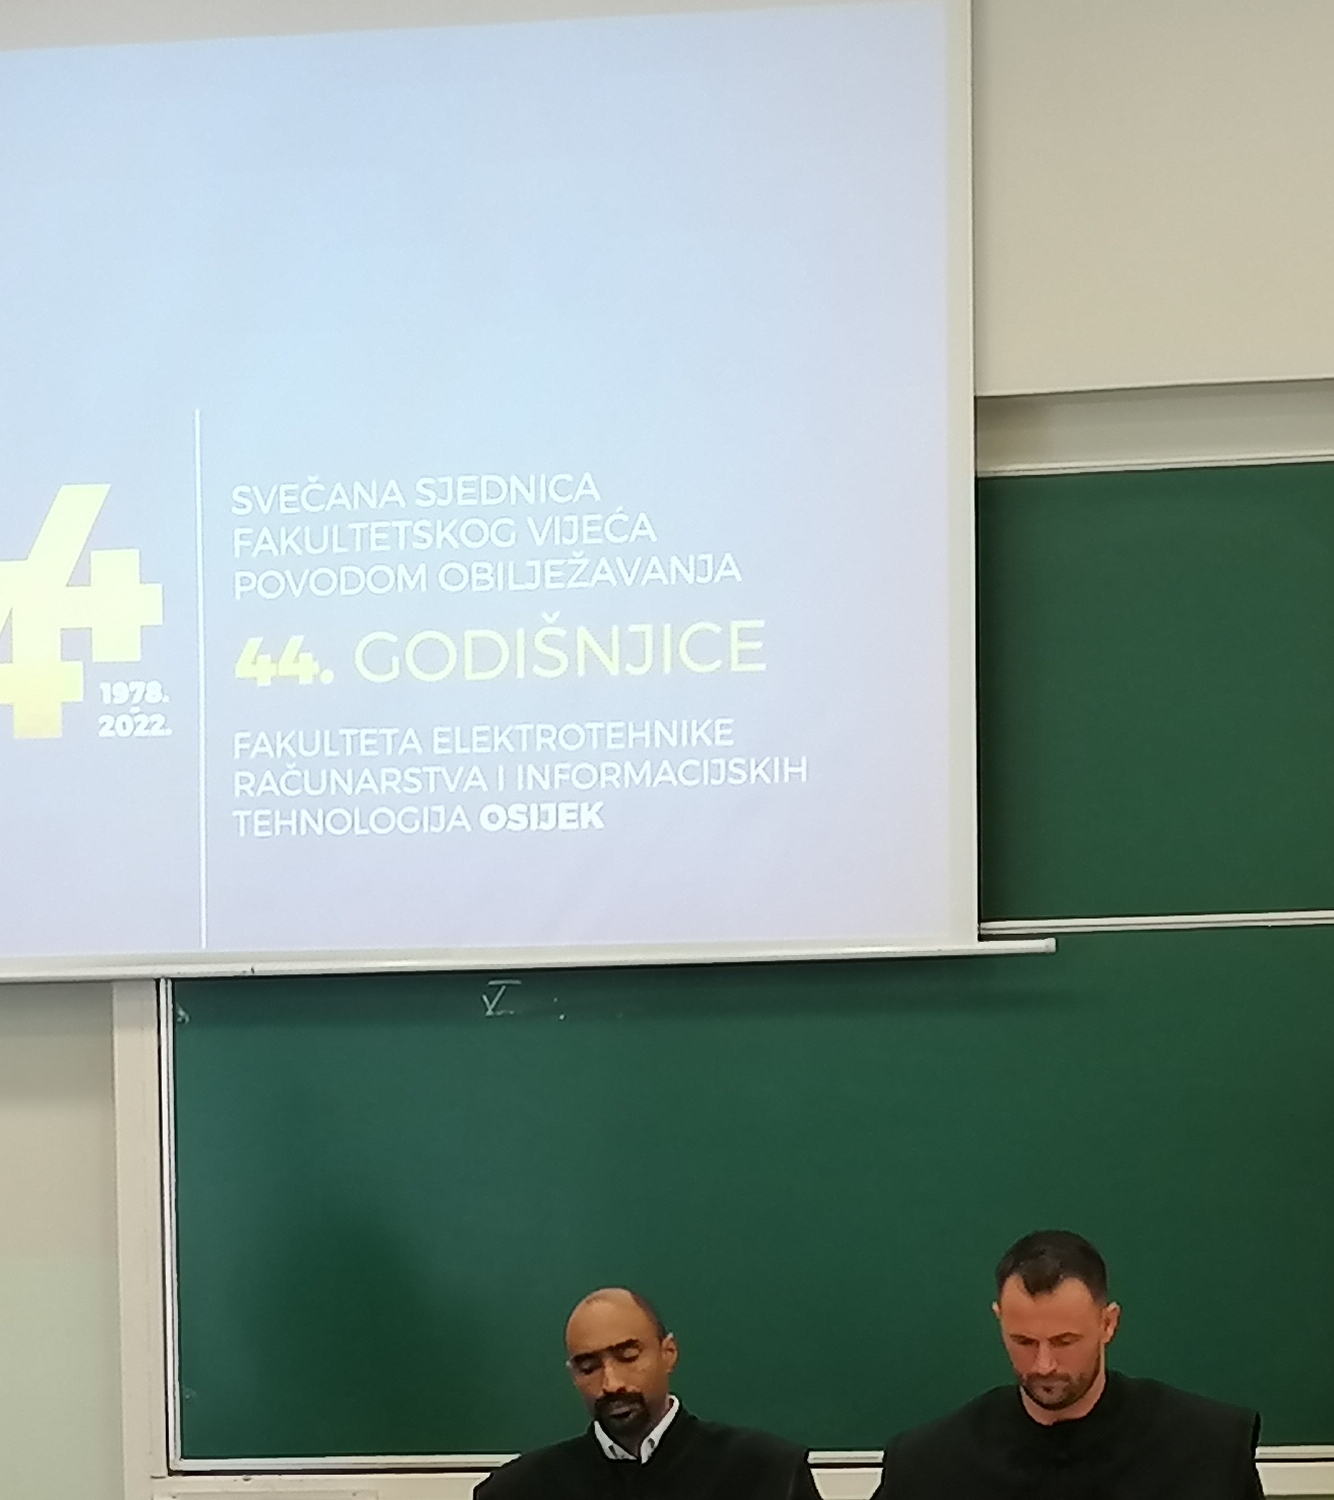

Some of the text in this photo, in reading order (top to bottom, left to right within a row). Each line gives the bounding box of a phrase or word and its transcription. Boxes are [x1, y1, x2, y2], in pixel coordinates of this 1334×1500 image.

[231, 471, 601, 516] SVEČANA SJEDNICA
[233, 506, 658, 558] FAKULTETSKOG VIJEĆA
[234, 550, 743, 601] POVODOM OBILJEŽAVANJA
[234, 611, 768, 687] 44. GODIŠNJICE
[99, 680, 170, 706] 1978.
[97, 713, 173, 738] 2022.
[232, 718, 735, 760] FAKULTETA ELEKTROTEHNIKE
[232, 755, 809, 799] RAČUNARSTVA I INFORMACIJSKIH
[232, 801, 605, 838] TEHNOLOGIJA OSIJEK
